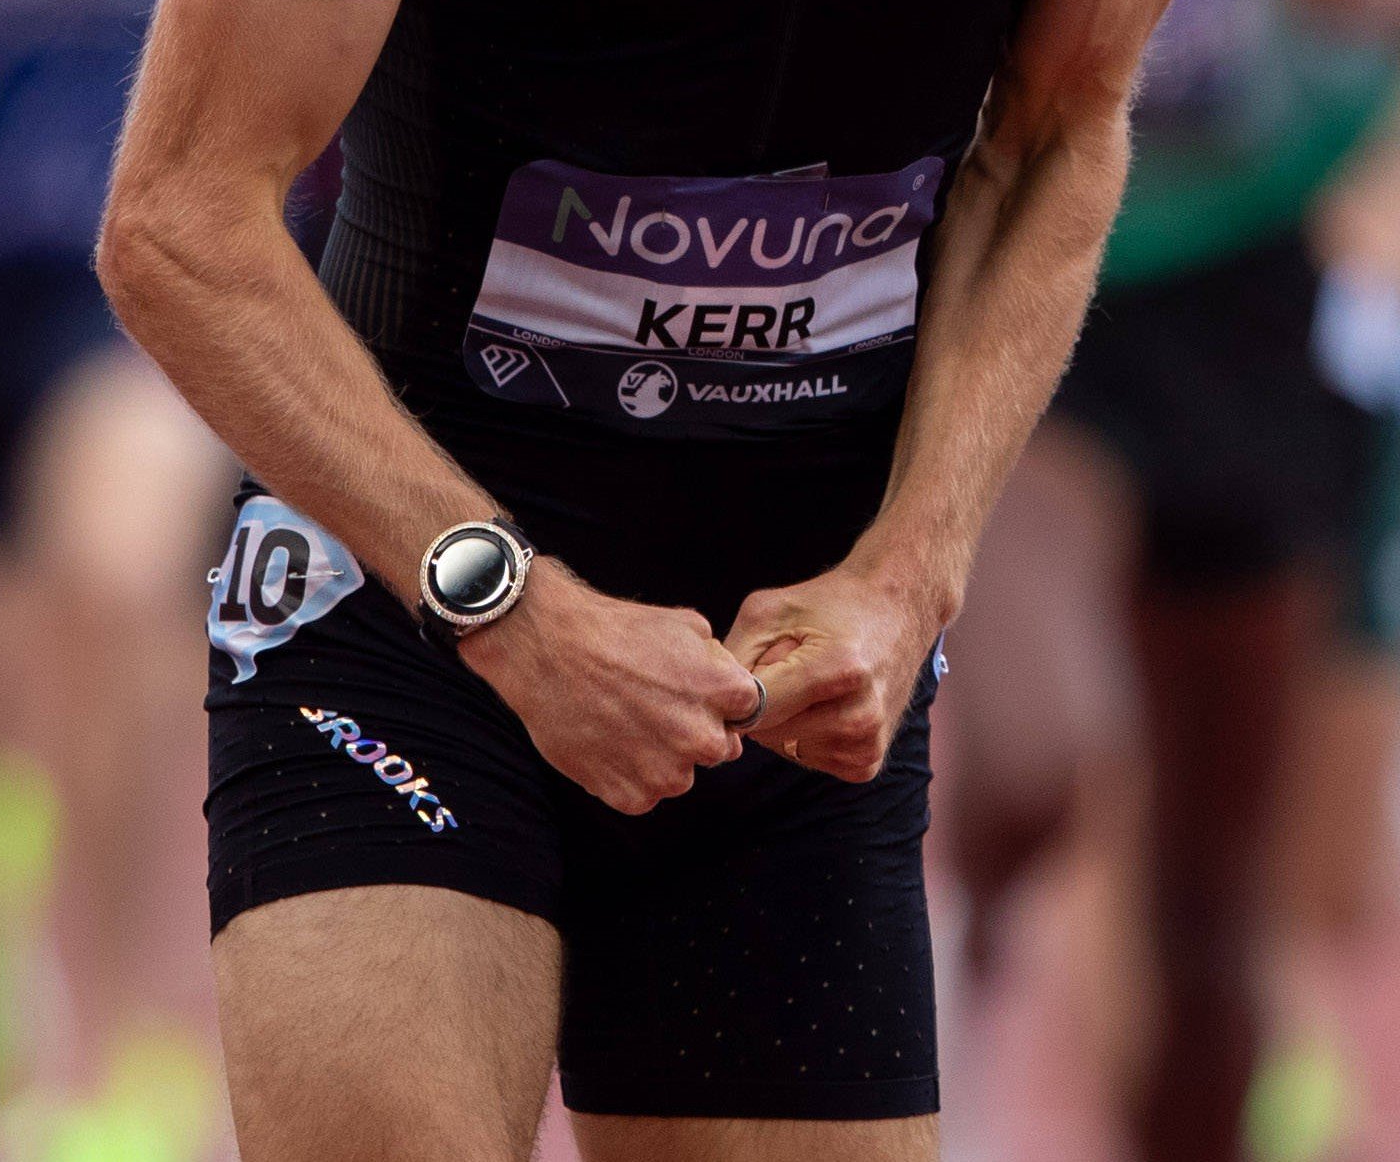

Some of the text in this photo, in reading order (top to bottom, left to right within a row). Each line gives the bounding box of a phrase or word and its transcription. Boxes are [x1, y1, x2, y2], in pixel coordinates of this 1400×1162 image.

[552, 186, 910, 269] Novuna
[512, 328, 569, 349] LONDO
[634, 296, 816, 350] KERR
[688, 347, 745, 361] LONDON
[686, 375, 848, 404] VAUXHALL
[219, 523, 311, 626] 10
